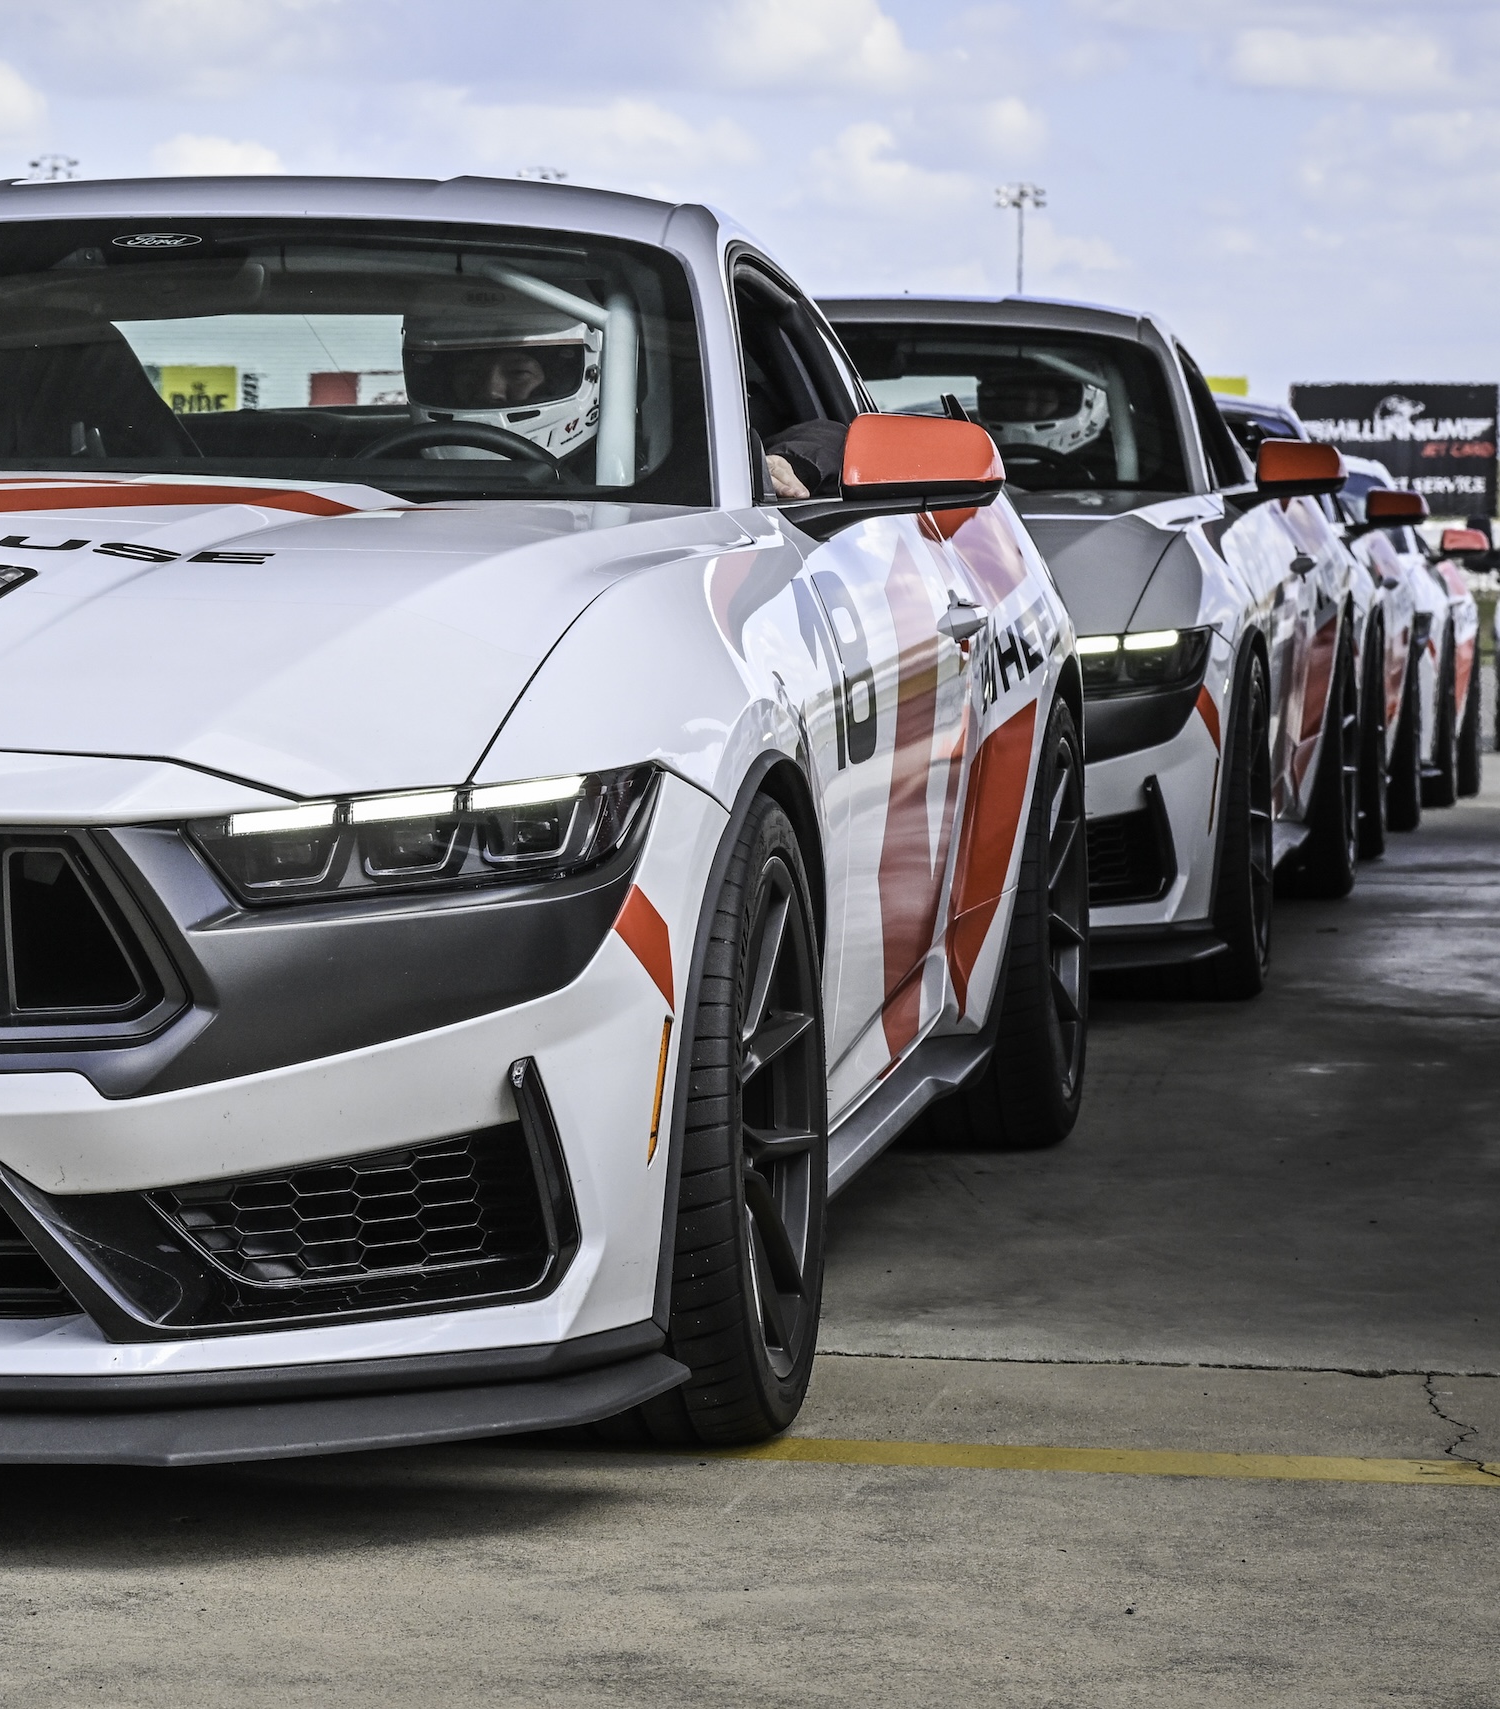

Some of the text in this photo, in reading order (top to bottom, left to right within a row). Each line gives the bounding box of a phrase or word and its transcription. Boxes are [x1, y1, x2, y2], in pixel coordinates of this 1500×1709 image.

[127, 235, 187, 246] Ford
[1412, 475, 1487, 494] SERVICE
[791, 571, 878, 771] 18
